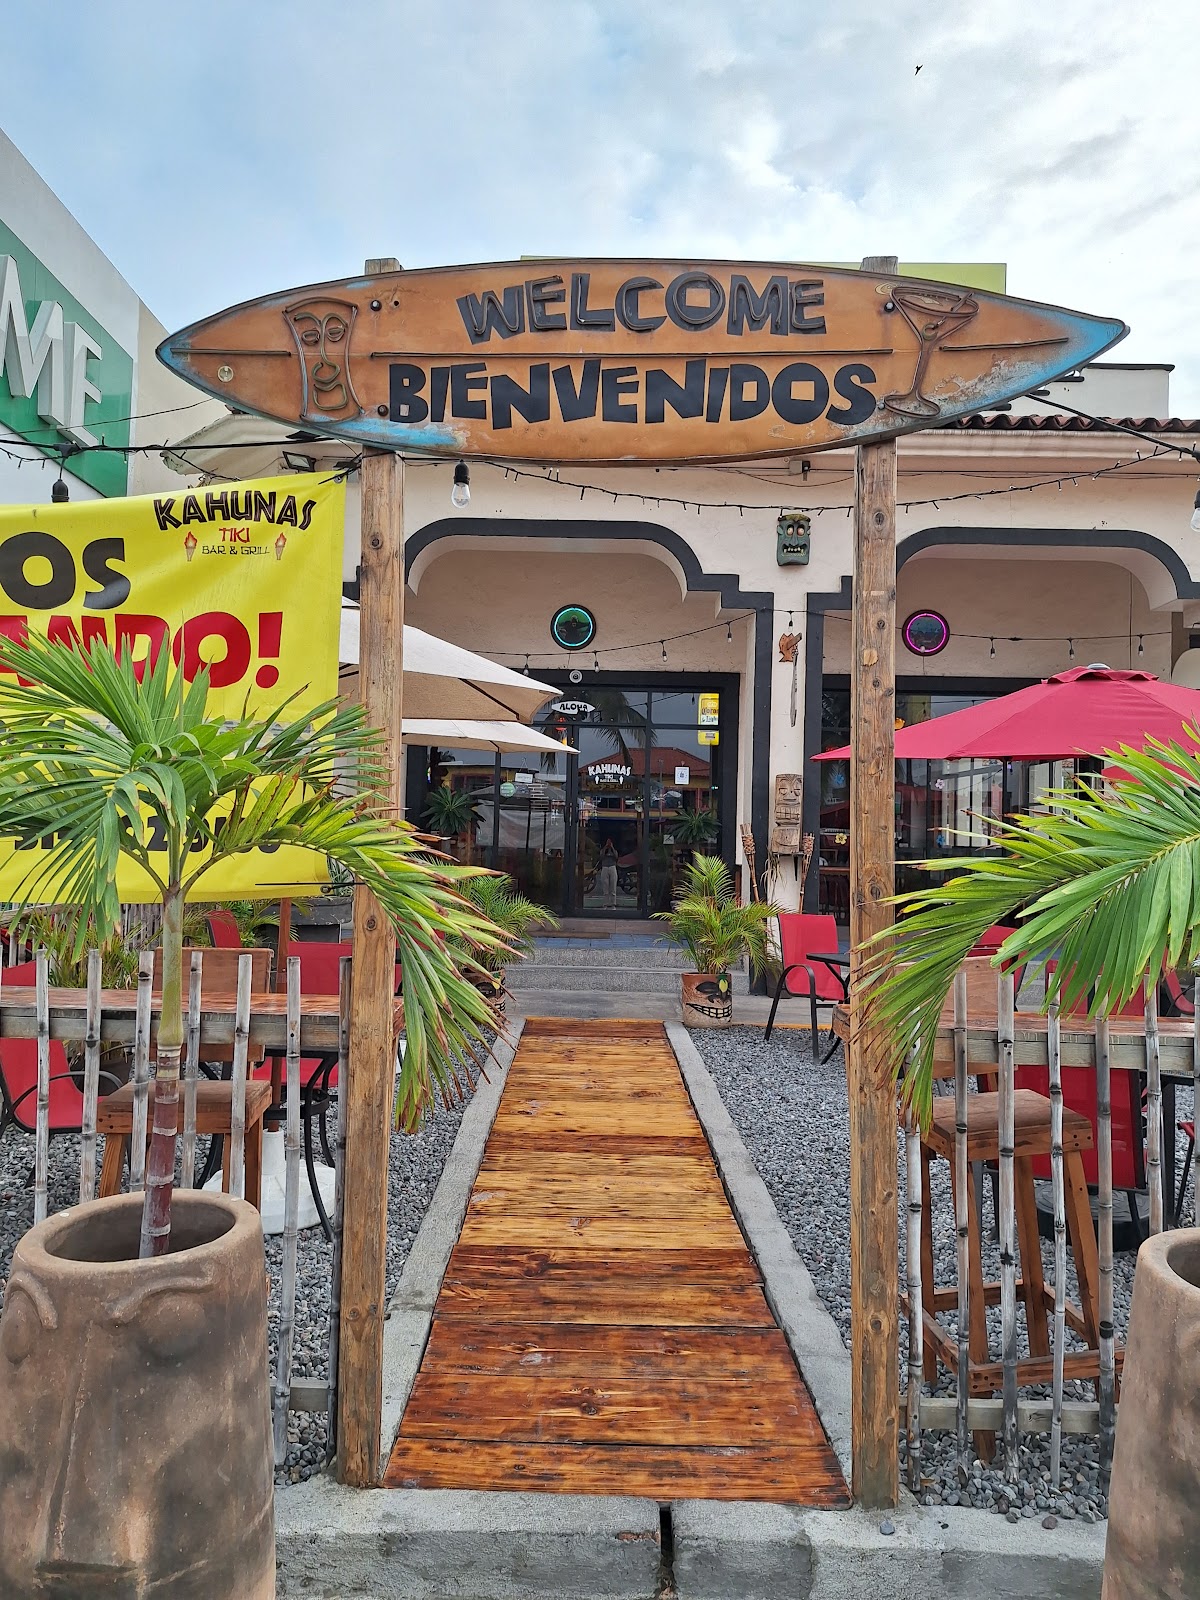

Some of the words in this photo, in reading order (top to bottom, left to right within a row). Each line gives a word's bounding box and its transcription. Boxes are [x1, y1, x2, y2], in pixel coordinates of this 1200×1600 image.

[456, 270, 827, 345] WELCOME
[388, 358, 877, 430] BIENVENIDOS
[153, 489, 317, 531] KAHUNAS
[218, 527, 251, 543] TIKI
[202, 546, 226, 555] BAR
[229, 546, 238, 555] &
[241, 546, 270, 555] GRILL
[560, 703, 588, 711] ALOHA
[588, 764, 631, 776] KAHUNAS
